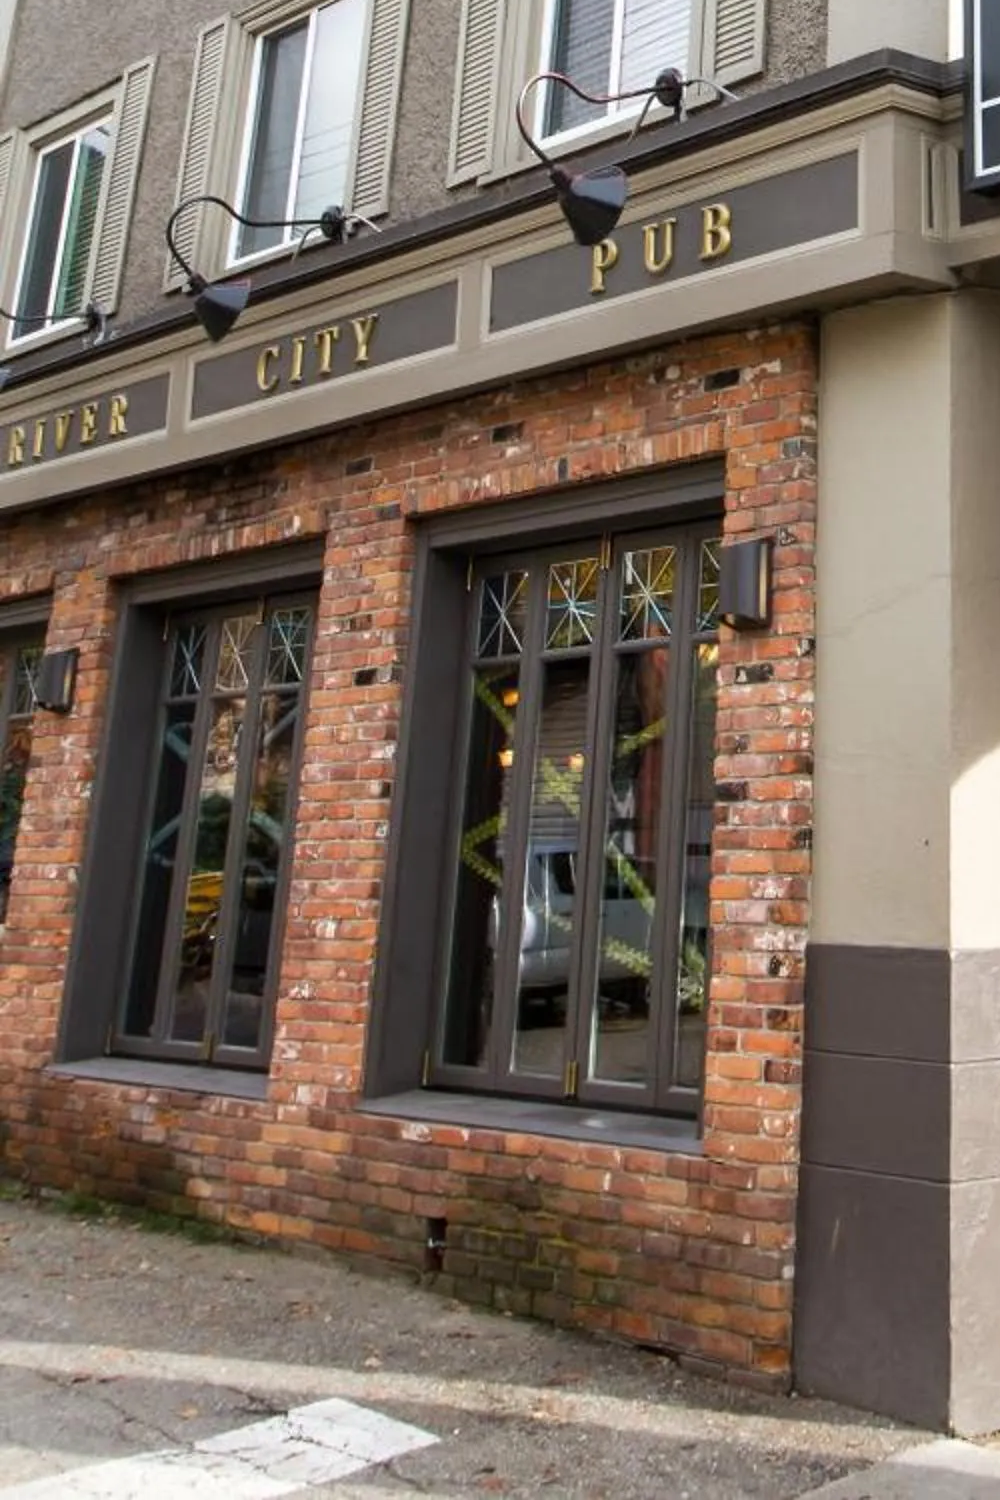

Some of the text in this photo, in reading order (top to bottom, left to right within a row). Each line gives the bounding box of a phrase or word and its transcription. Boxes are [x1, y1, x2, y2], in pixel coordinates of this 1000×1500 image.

[8, 203, 732, 466] RIVER CITY PUB
